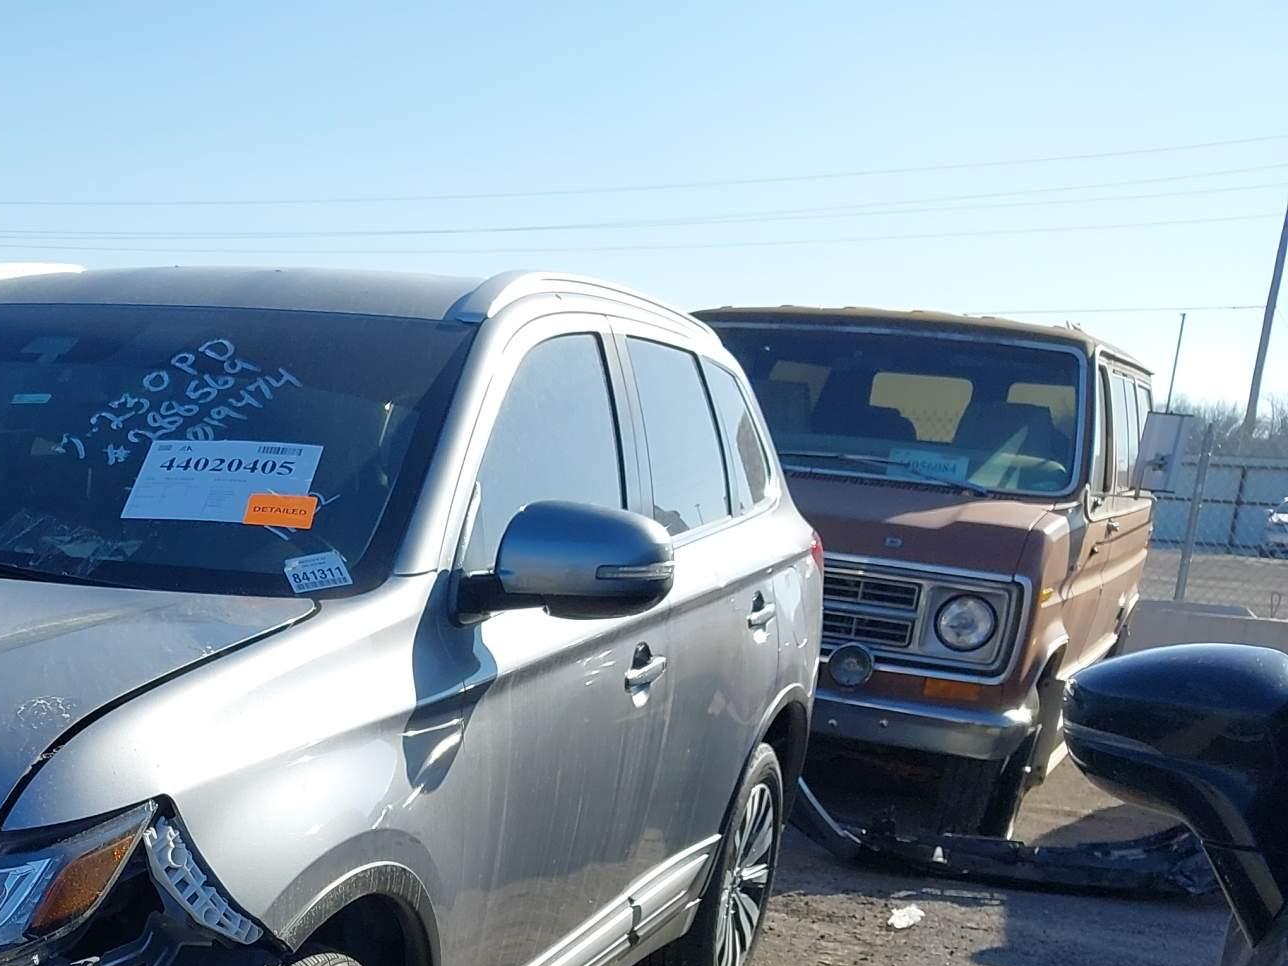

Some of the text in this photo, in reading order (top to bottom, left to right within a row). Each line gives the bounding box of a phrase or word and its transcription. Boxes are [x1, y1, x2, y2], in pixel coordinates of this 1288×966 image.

[160, 456, 296, 476] 44020405
[253, 505, 307, 516] DETAILED
[292, 566, 344, 583] 841311
